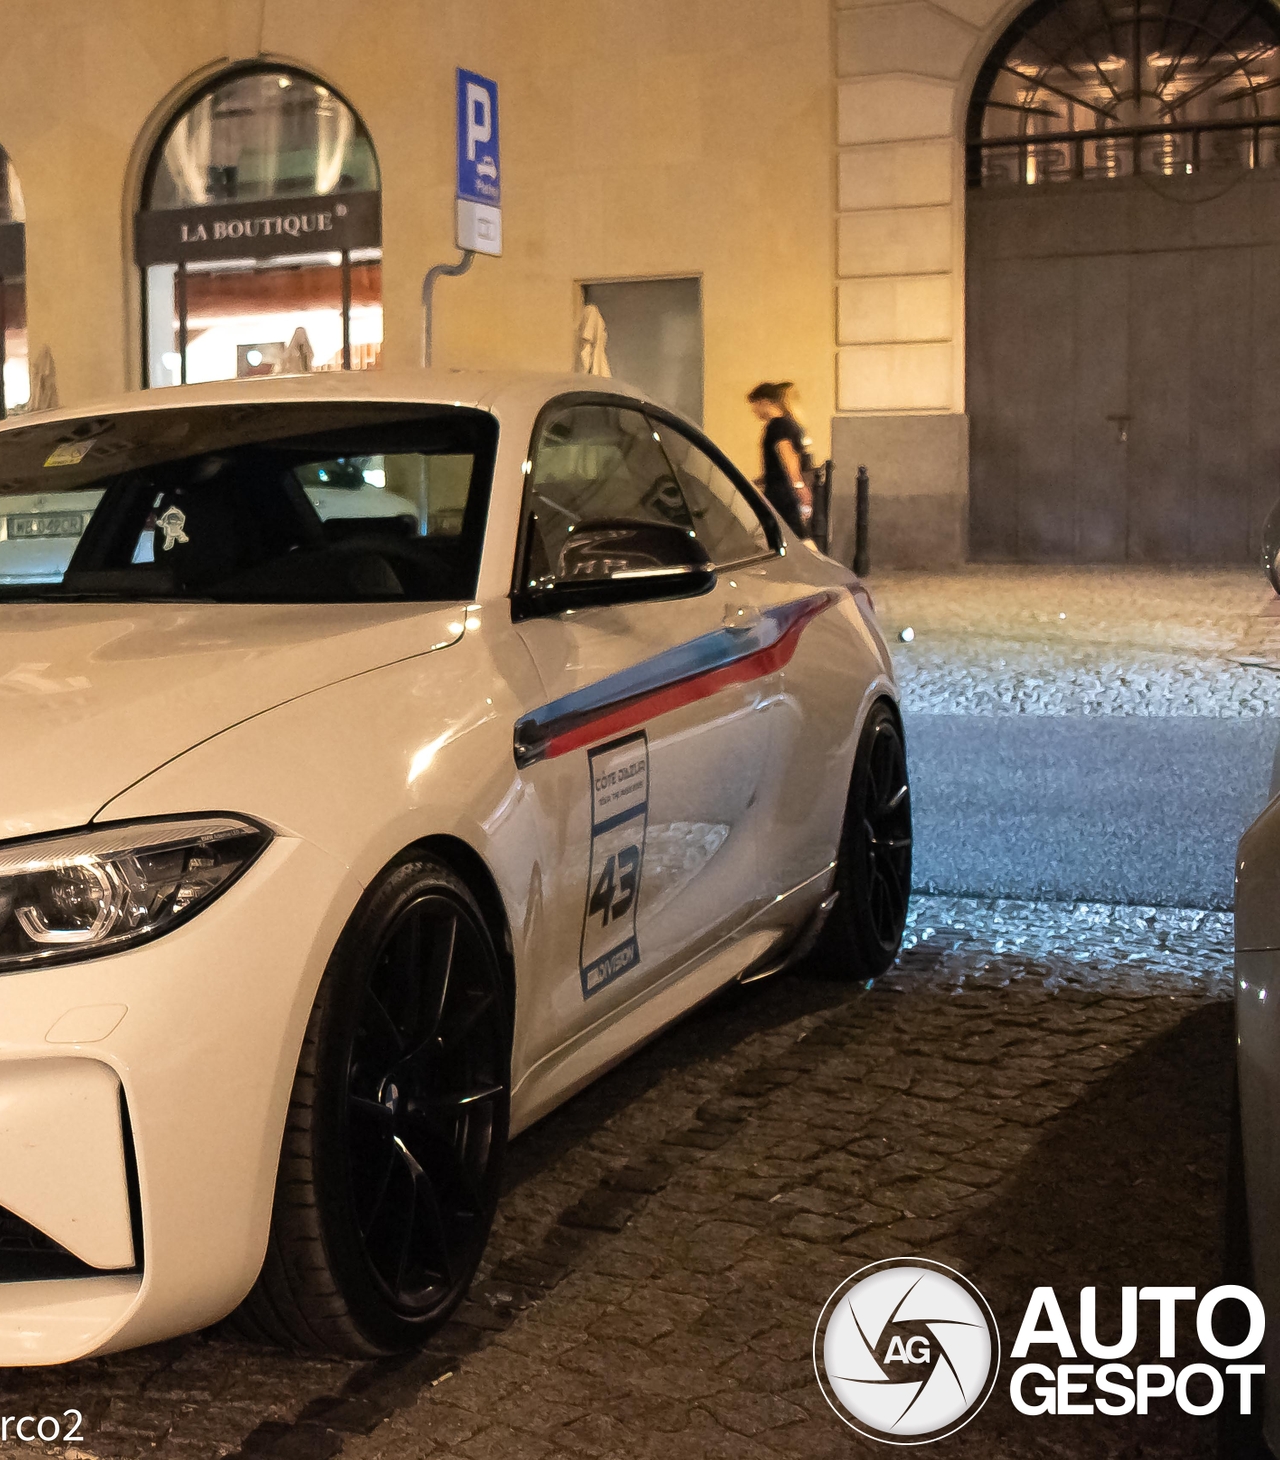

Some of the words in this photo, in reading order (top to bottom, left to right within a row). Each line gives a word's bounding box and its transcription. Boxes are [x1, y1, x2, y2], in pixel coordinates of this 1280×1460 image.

[466, 82, 492, 161] P
[181, 224, 207, 242] LA
[589, 844, 640, 928] 43
